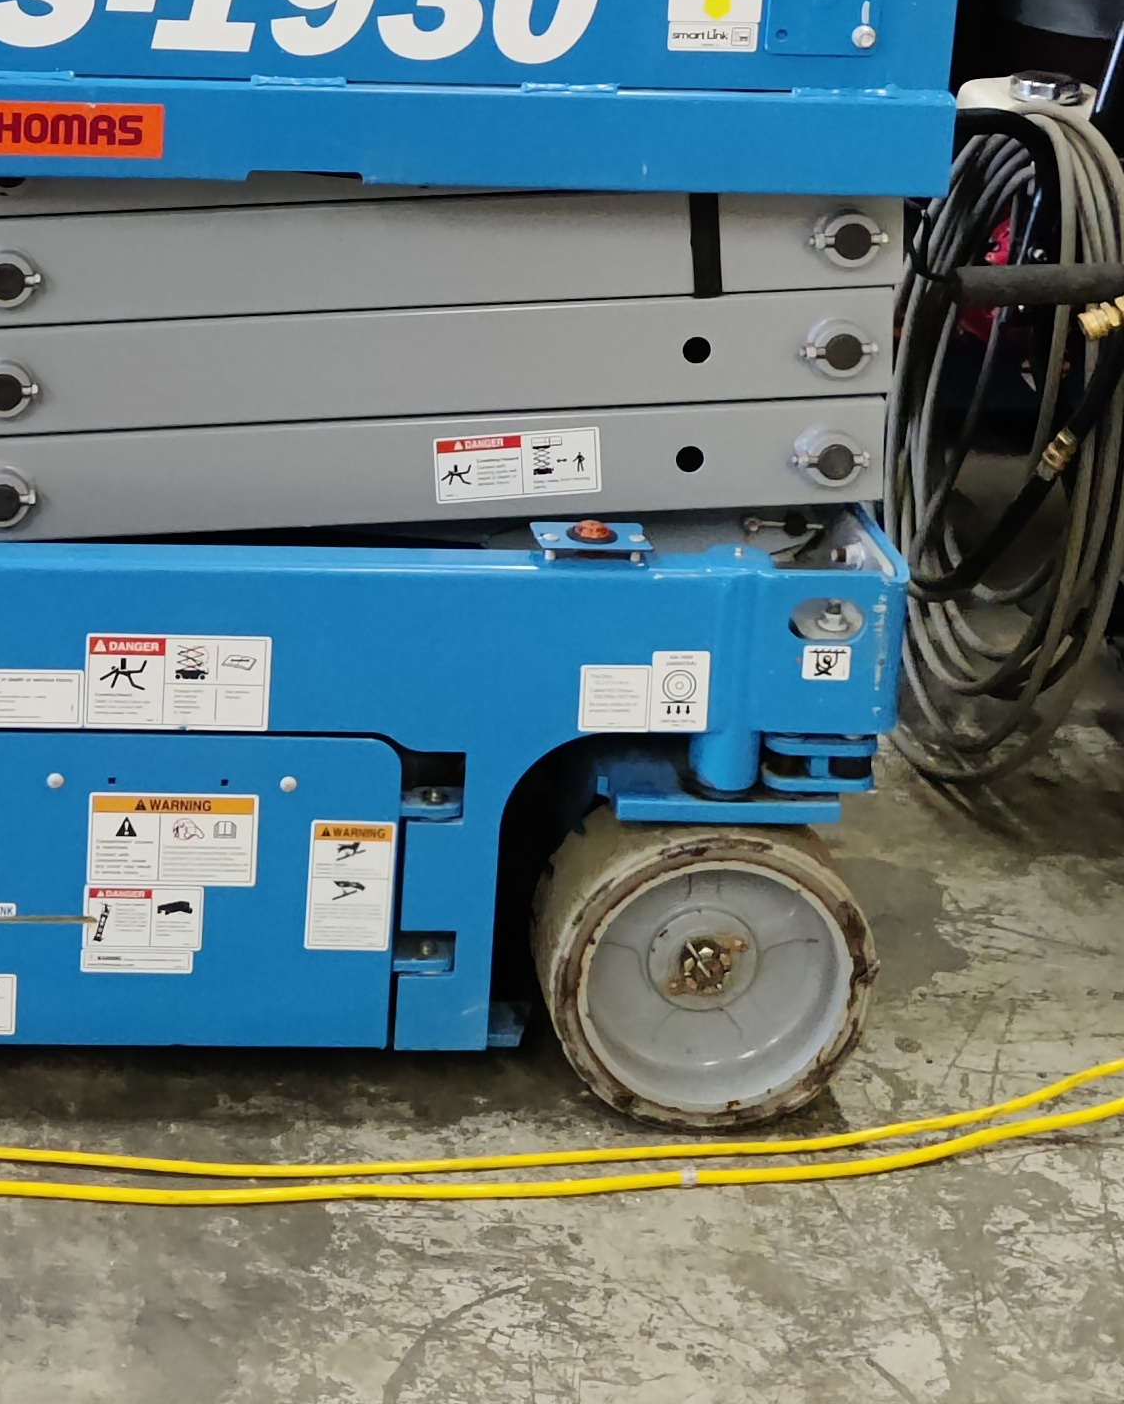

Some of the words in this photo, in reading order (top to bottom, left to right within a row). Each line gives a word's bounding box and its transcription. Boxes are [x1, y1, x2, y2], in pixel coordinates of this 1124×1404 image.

[463, 437, 505, 450] DANGER
[108, 640, 160, 652] DANGER
[149, 799, 212, 812] WARNING
[333, 827, 386, 839] WARNING
[106, 889, 146, 898] DANGER
